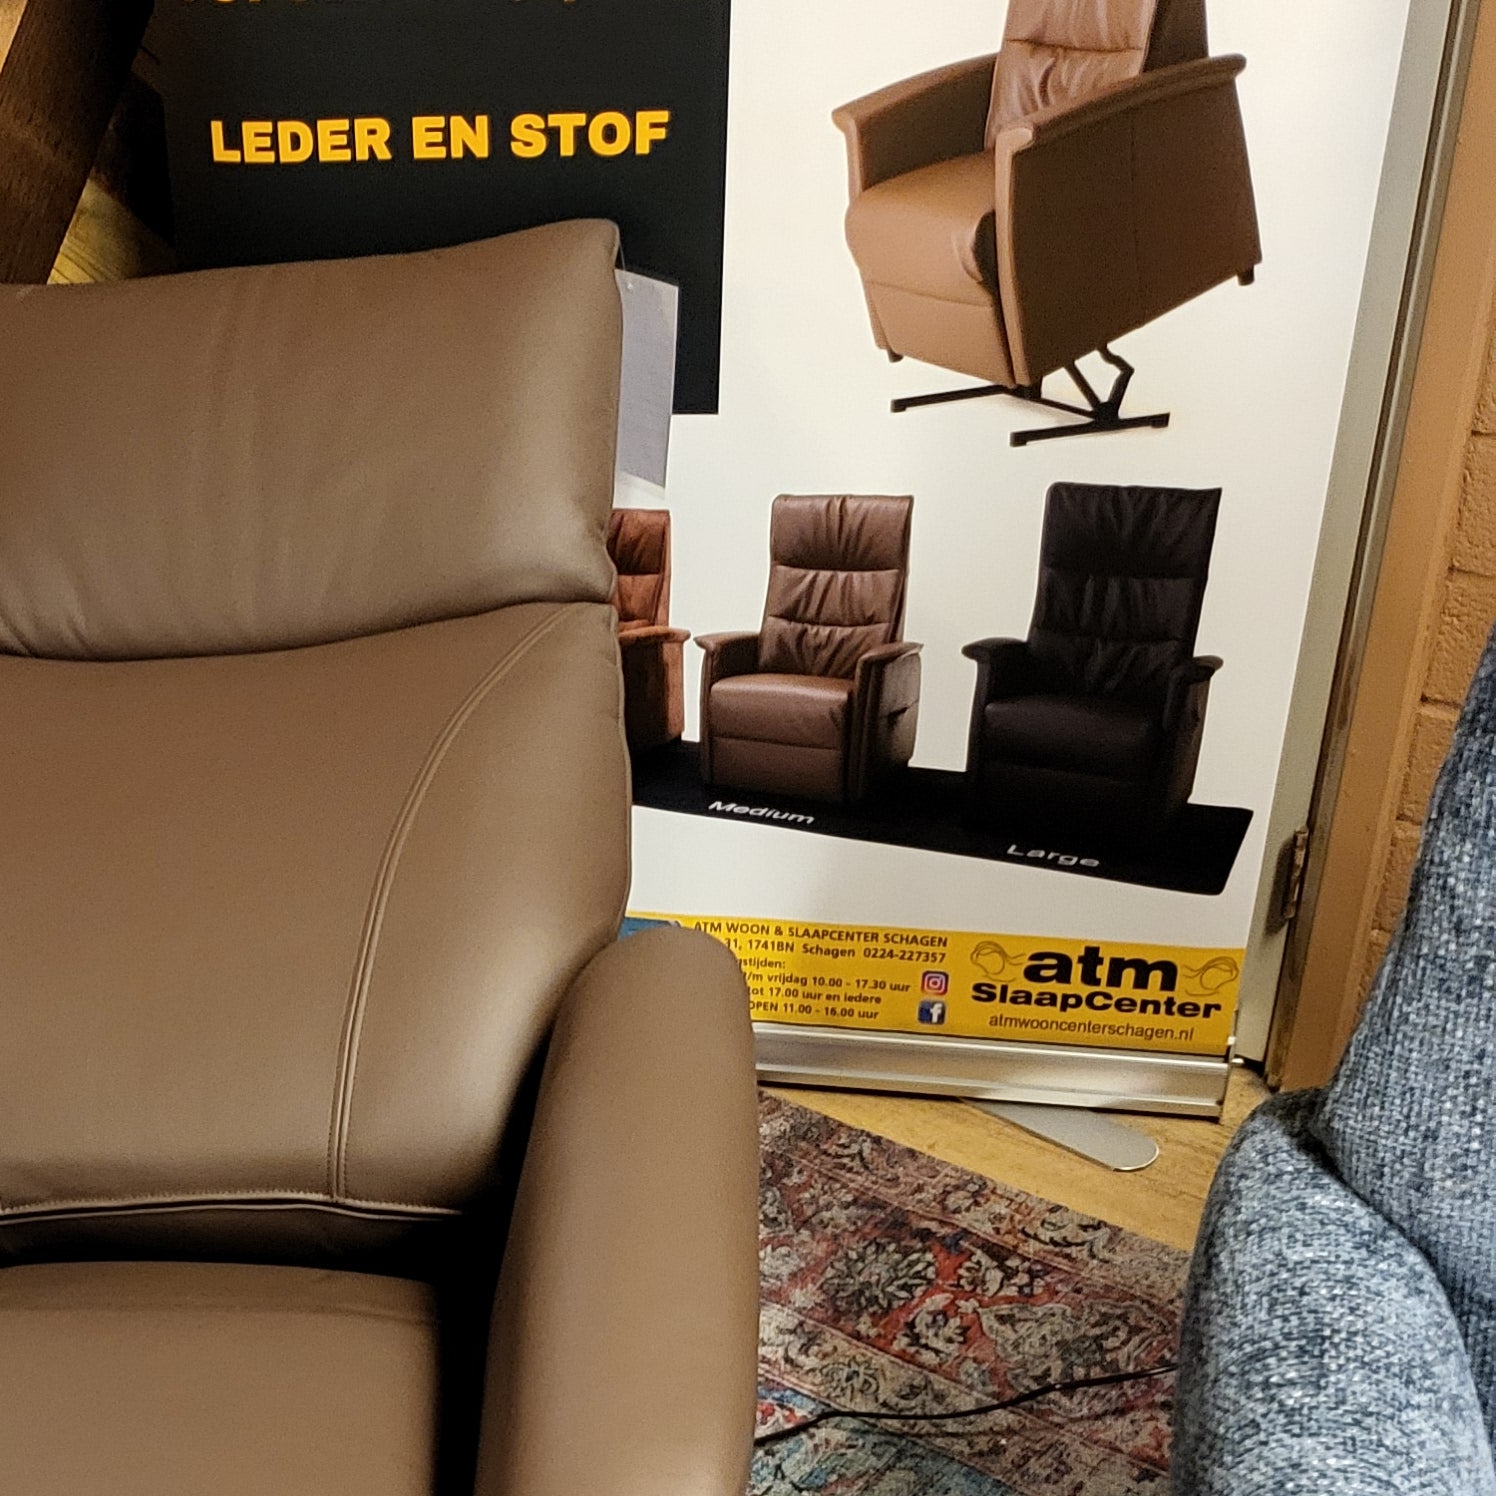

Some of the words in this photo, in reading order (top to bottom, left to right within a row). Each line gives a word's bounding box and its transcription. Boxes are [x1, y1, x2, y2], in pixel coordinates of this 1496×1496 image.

[209, 118, 392, 163] LEDER
[411, 115, 490, 160] EN
[509, 110, 670, 158] STOF
[708, 800, 815, 824] Medium
[1006, 844, 1100, 867] Large
[694, 921, 722, 933] ATM
[725, 922, 770, 935] WOON
[774, 925, 784, 936] &
[788, 927, 879, 943] SLAAPCENTER
[883, 933, 948, 947] SCHAGEN
[748, 939, 795, 953] 1741BN
[802, 943, 856, 959] Schagen
[863, 947, 946, 963] 0224-227357
[1023, 945, 1179, 992] atm
[767, 973, 808, 987] vrijdag
[812, 976, 843, 988] 10.00
[855, 978, 886, 990] 17.30
[889, 983, 911, 992] uur
[769, 987, 799, 998] 17.00
[802, 991, 823, 1001] uur
[825, 993, 840, 1001] en
[843, 993, 882, 1005] iedere
[971, 982, 1222, 1018] SlaapCenter
[783, 1002, 812, 1015] 11.00
[858, 1009, 879, 1019] uur
[988, 1013, 1195, 1041] atmwooncenterschagen.nl
